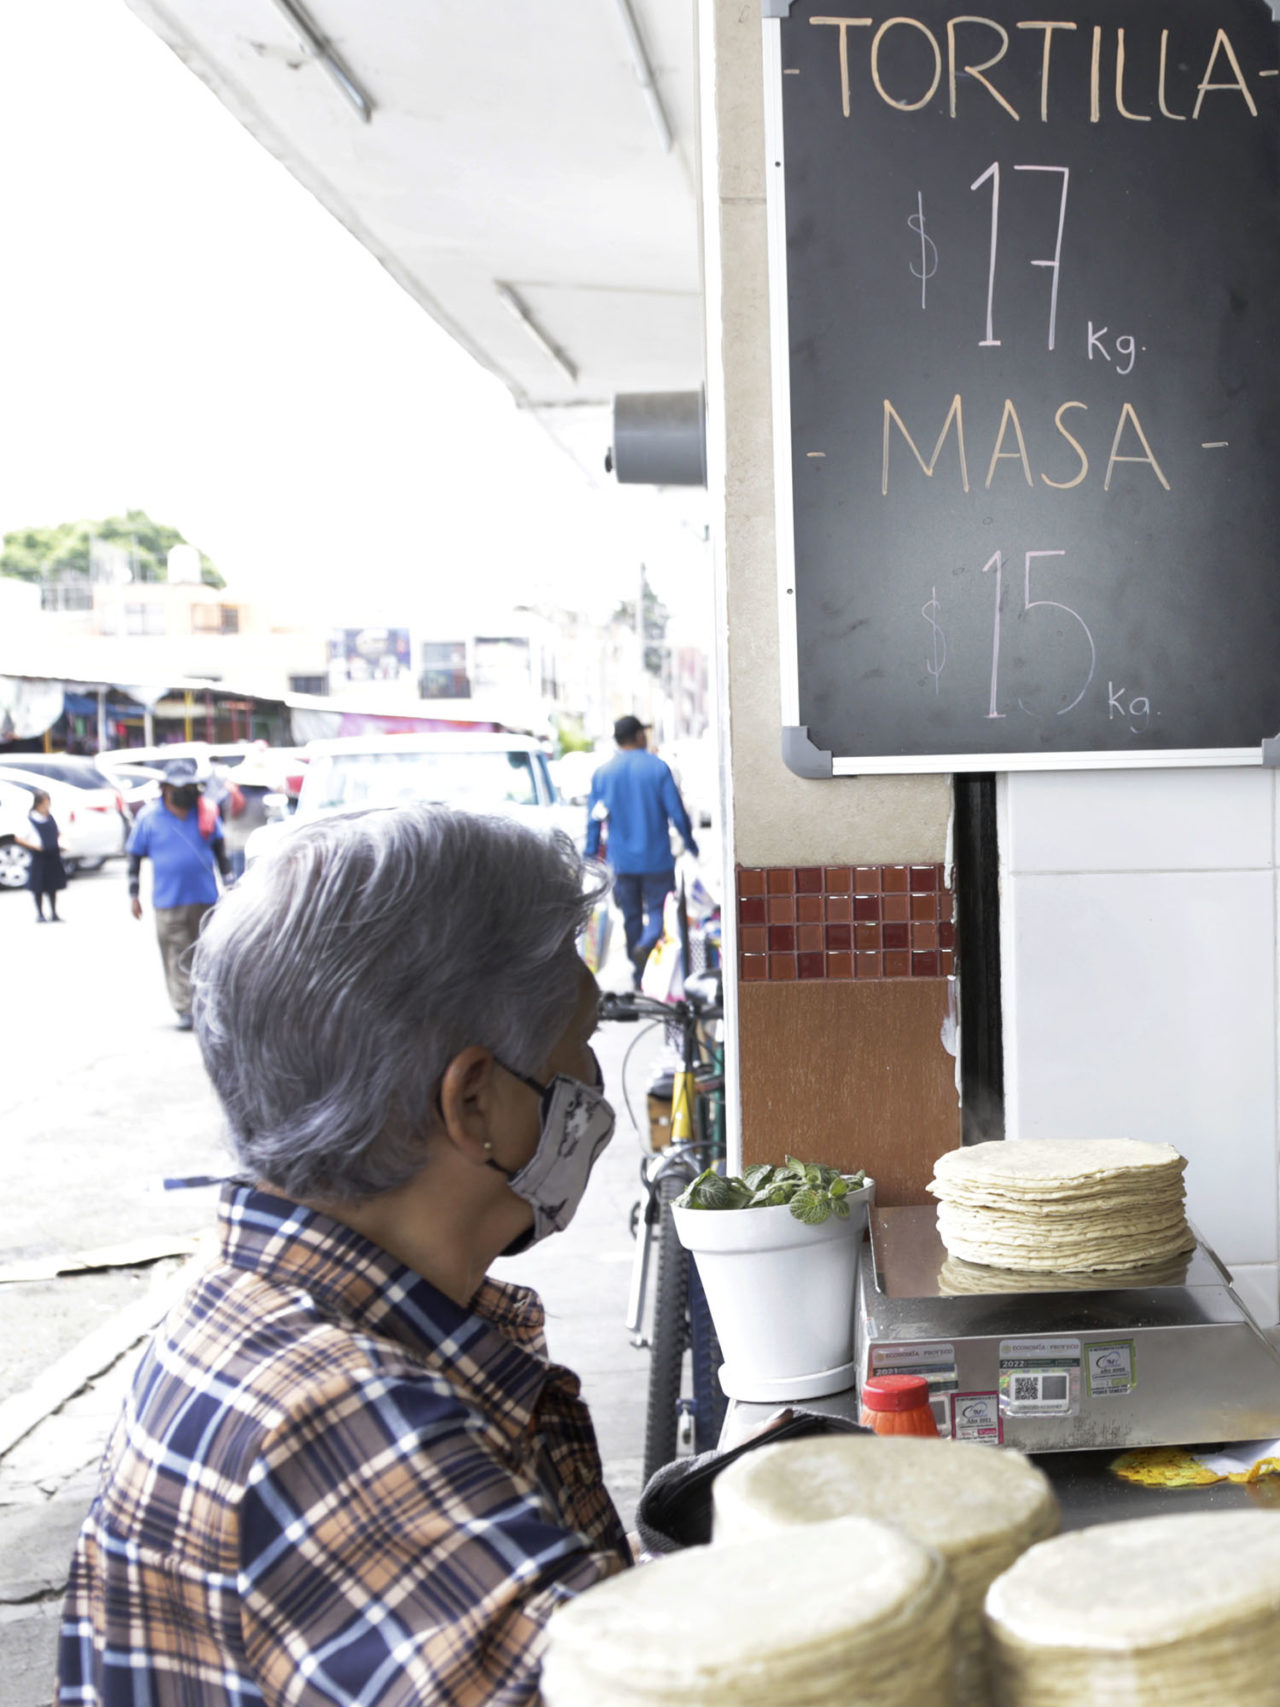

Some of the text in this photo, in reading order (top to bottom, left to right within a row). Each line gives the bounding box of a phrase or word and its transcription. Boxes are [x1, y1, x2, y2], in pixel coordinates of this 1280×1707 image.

[809, 17, 1257, 121] TORTILLA
[882, 394, 1170, 495] MASA
[1002, 1360, 1025, 1368] 2022
